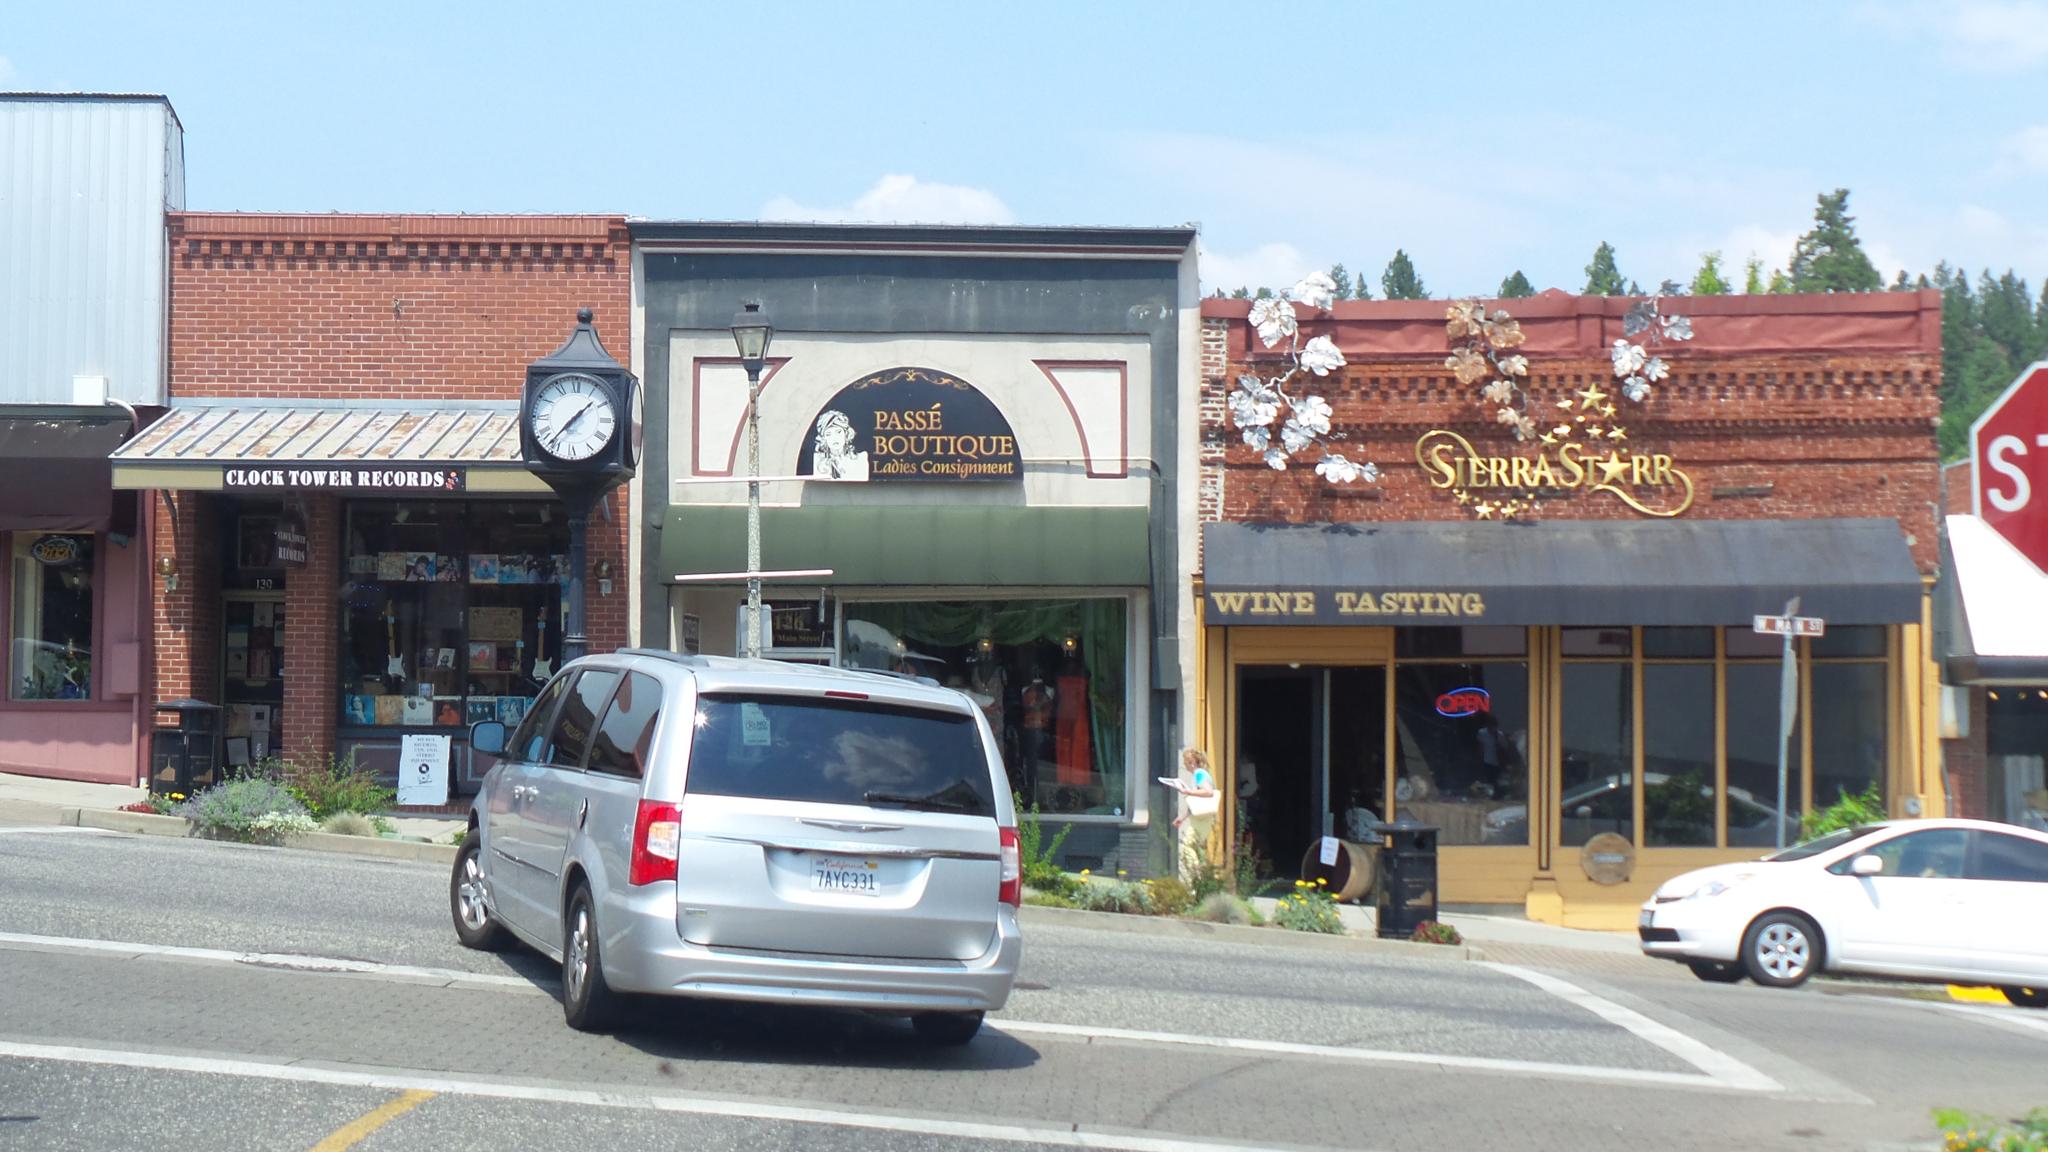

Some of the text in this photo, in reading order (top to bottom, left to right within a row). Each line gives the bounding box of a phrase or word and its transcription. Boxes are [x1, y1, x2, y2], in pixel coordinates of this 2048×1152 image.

[873, 402, 943, 430] PASSÉ
[873, 435, 1014, 459] BOUTIQUE
[226, 469, 445, 487] CLOCK TOWER RECORDS
[872, 458, 1014, 478] Ladies Consignment
[1987, 434, 2048, 512] S
[1211, 592, 1485, 615] WINE TASTING
[1775, 619, 1803, 633] MAN
[1435, 694, 1490, 713] OPEN
[816, 870, 875, 889] 7AYC331
